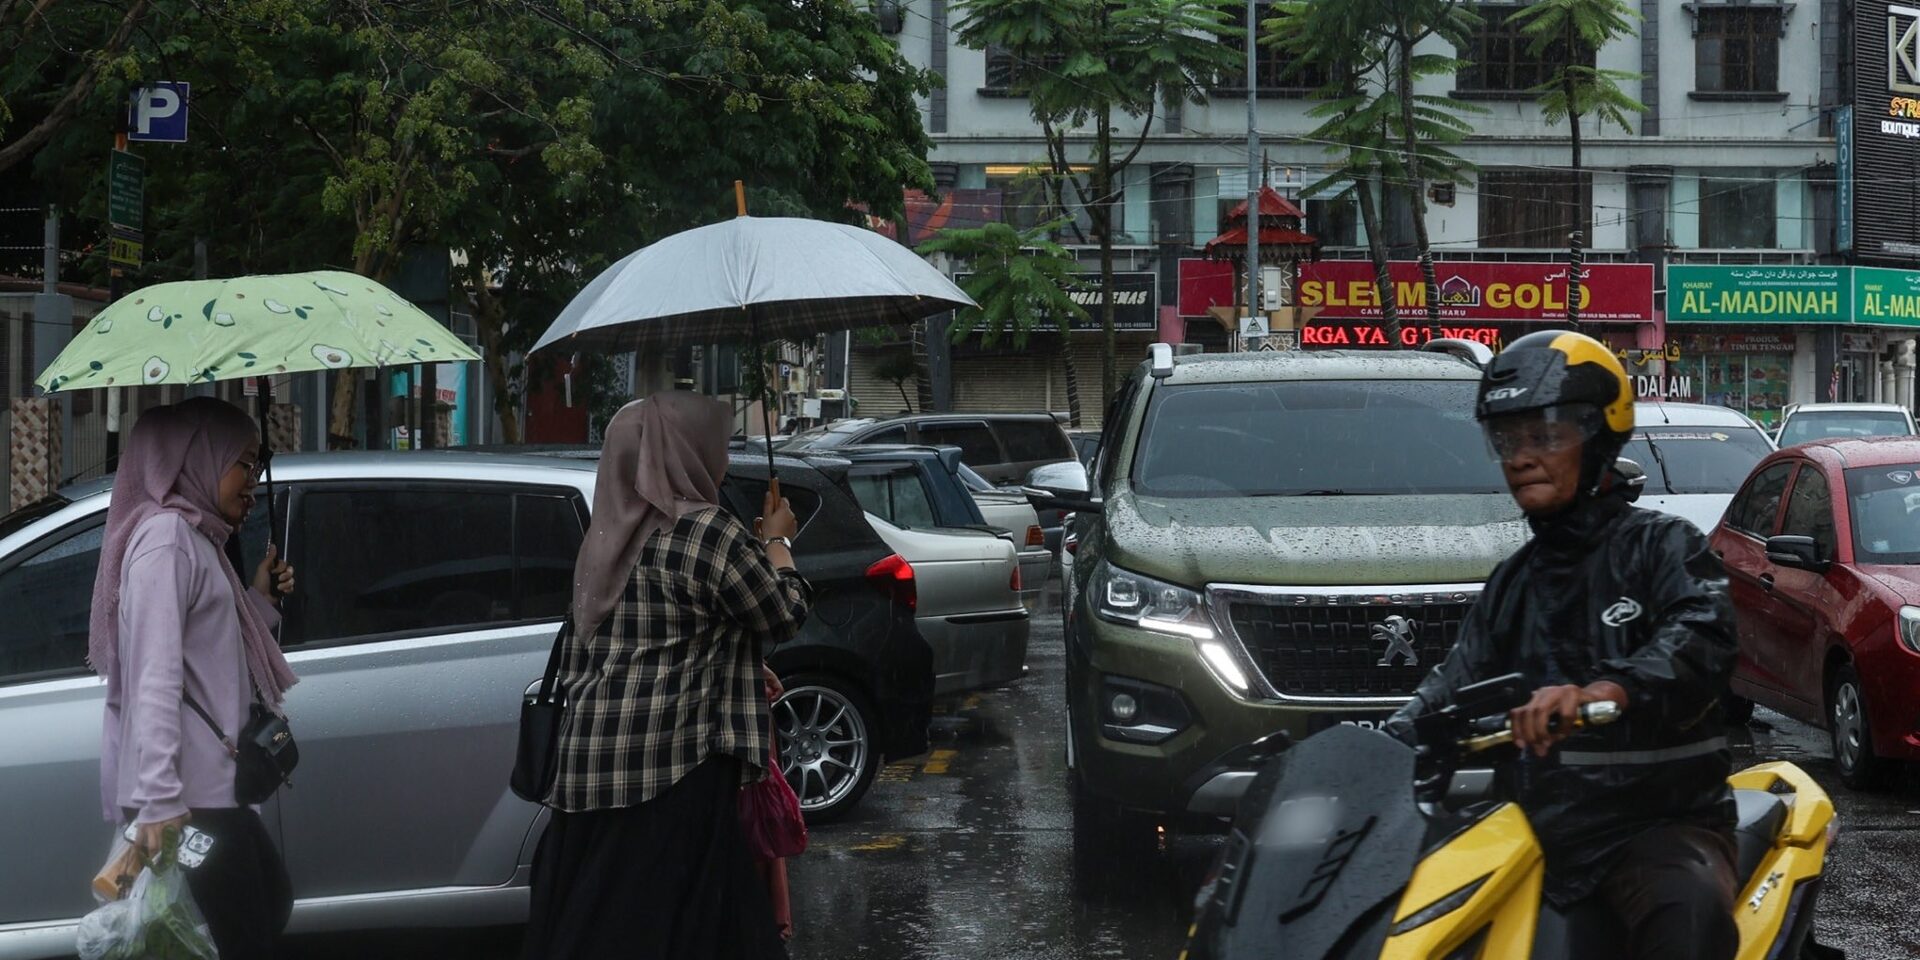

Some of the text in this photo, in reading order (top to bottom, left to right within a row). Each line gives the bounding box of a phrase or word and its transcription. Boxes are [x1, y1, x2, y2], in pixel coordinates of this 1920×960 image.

[137, 87, 180, 134] P
[1485, 283, 1590, 310] GOLD
[1681, 291, 1838, 314] AL-MADINAH
[1437, 309, 1466, 317] HARU
[1353, 327, 1418, 345] YAG
[1422, 328, 1499, 345] TNGGI
[1730, 343, 1795, 351] TIMUR TENGAH
[1637, 375, 1691, 398] DALAM
[1295, 592, 1467, 606] PEUGEO
